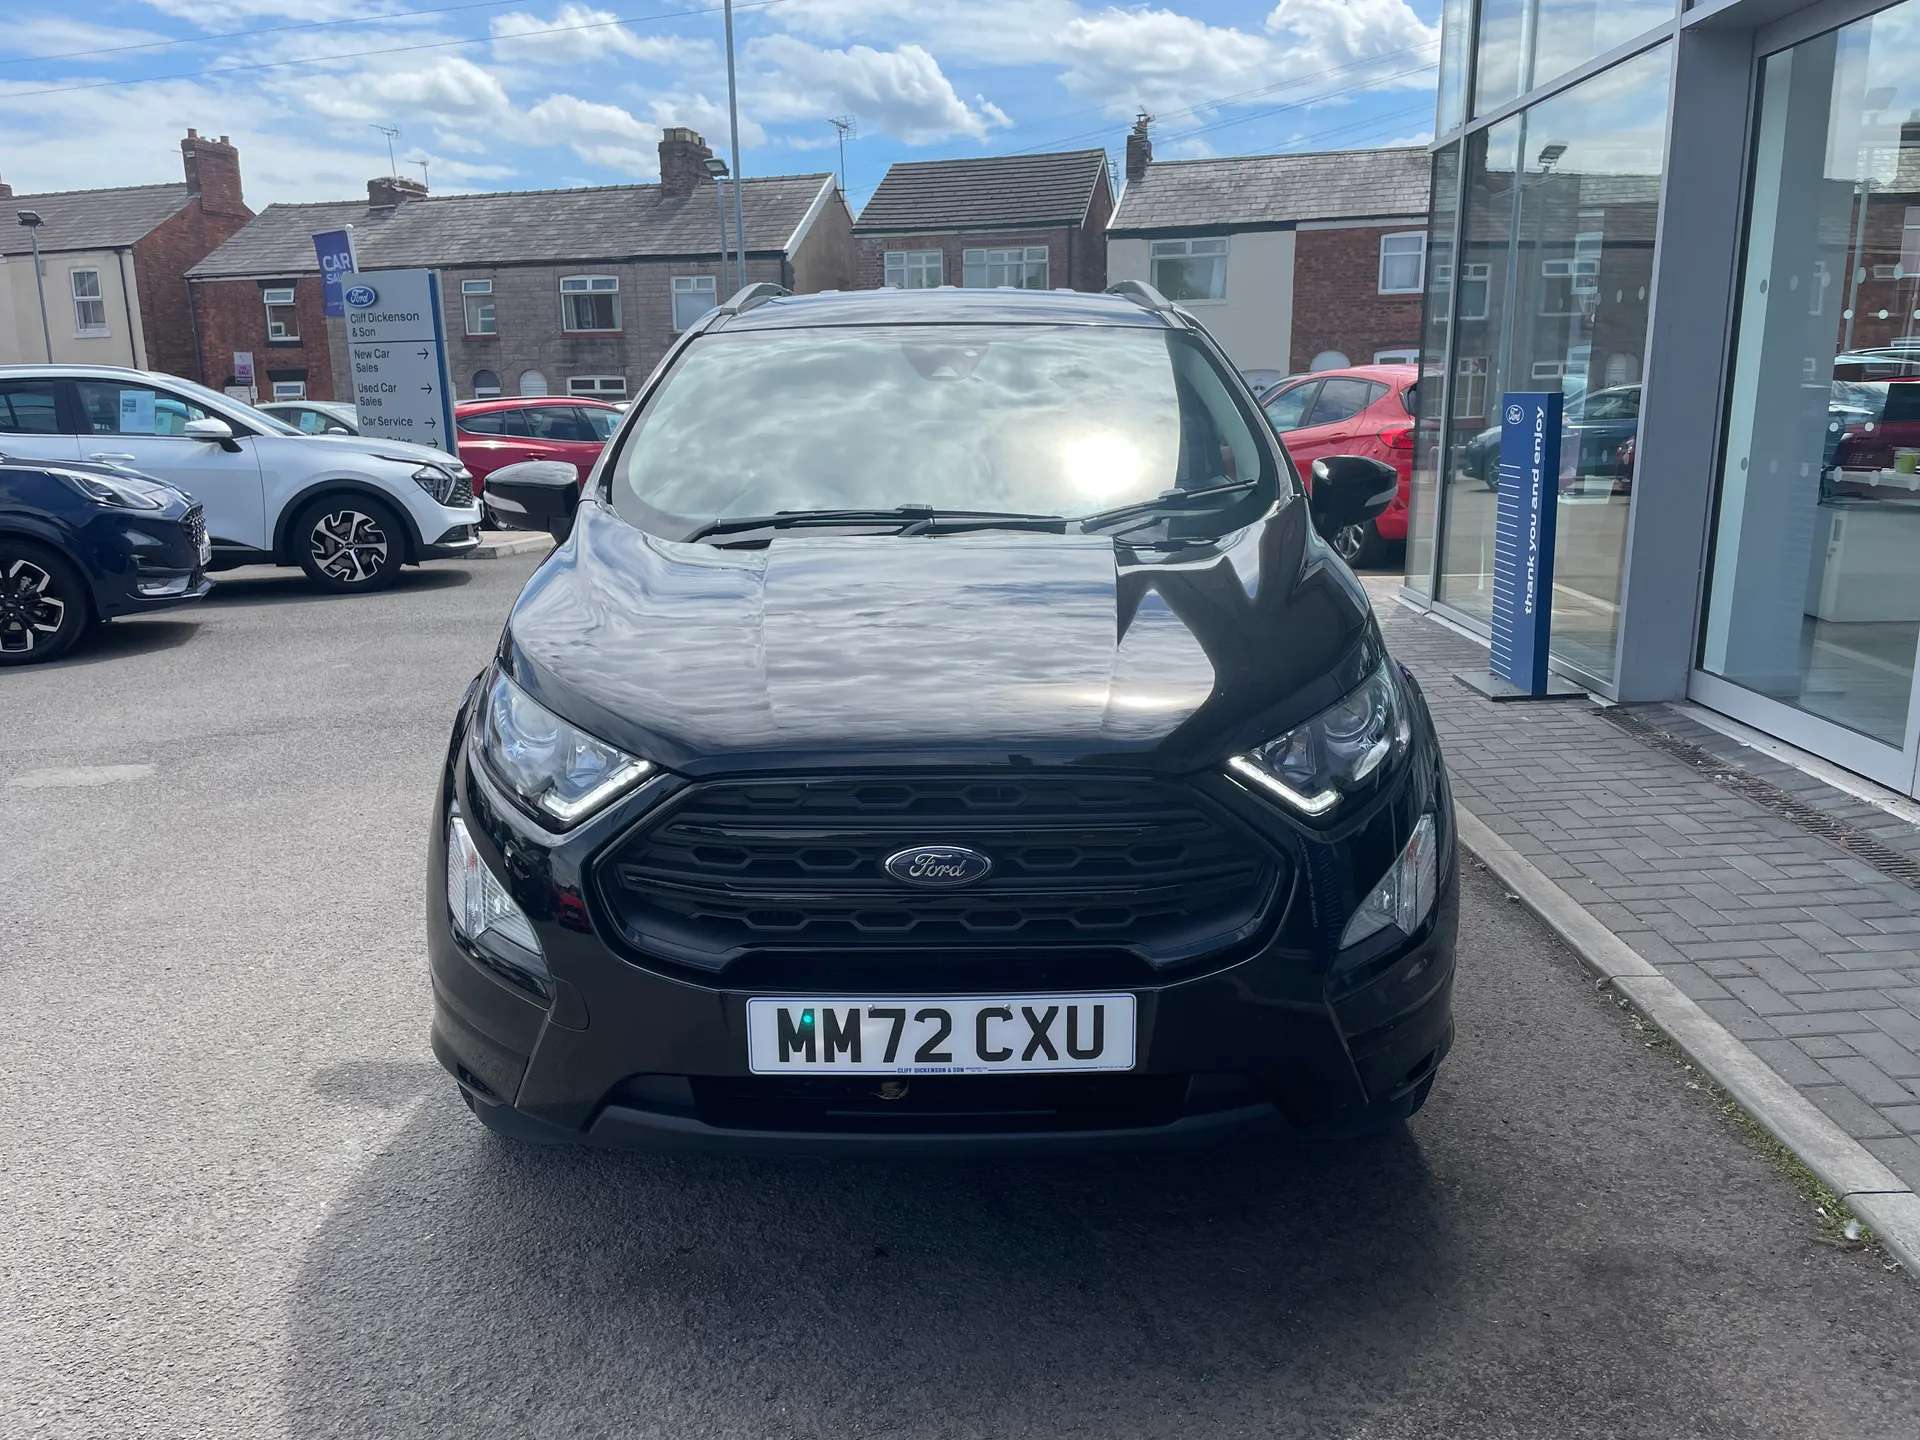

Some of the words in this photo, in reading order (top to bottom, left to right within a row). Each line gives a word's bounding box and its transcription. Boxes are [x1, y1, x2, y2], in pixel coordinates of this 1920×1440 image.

[322, 252, 351, 271] CAR
[350, 313, 366, 324] Cliff
[368, 312, 420, 323] Dickenson
[352, 327, 358, 337] &
[359, 327, 376, 337] Son
[354, 349, 372, 359] New
[374, 348, 390, 359] Car
[355, 362, 379, 373] Sales
[358, 383, 379, 393] Used
[380, 382, 397, 393] Car
[360, 396, 383, 407] Sales
[361, 416, 376, 426] Car
[377, 416, 413, 427] Service
[1533, 405, 1544, 465] enjoy
[1531, 468, 1540, 510] and
[1528, 513, 1538, 552] you
[1524, 555, 1535, 615] thank
[908, 853, 967, 877] Ford
[776, 1007, 953, 1063] MM72
[975, 1004, 1105, 1062] CXU
